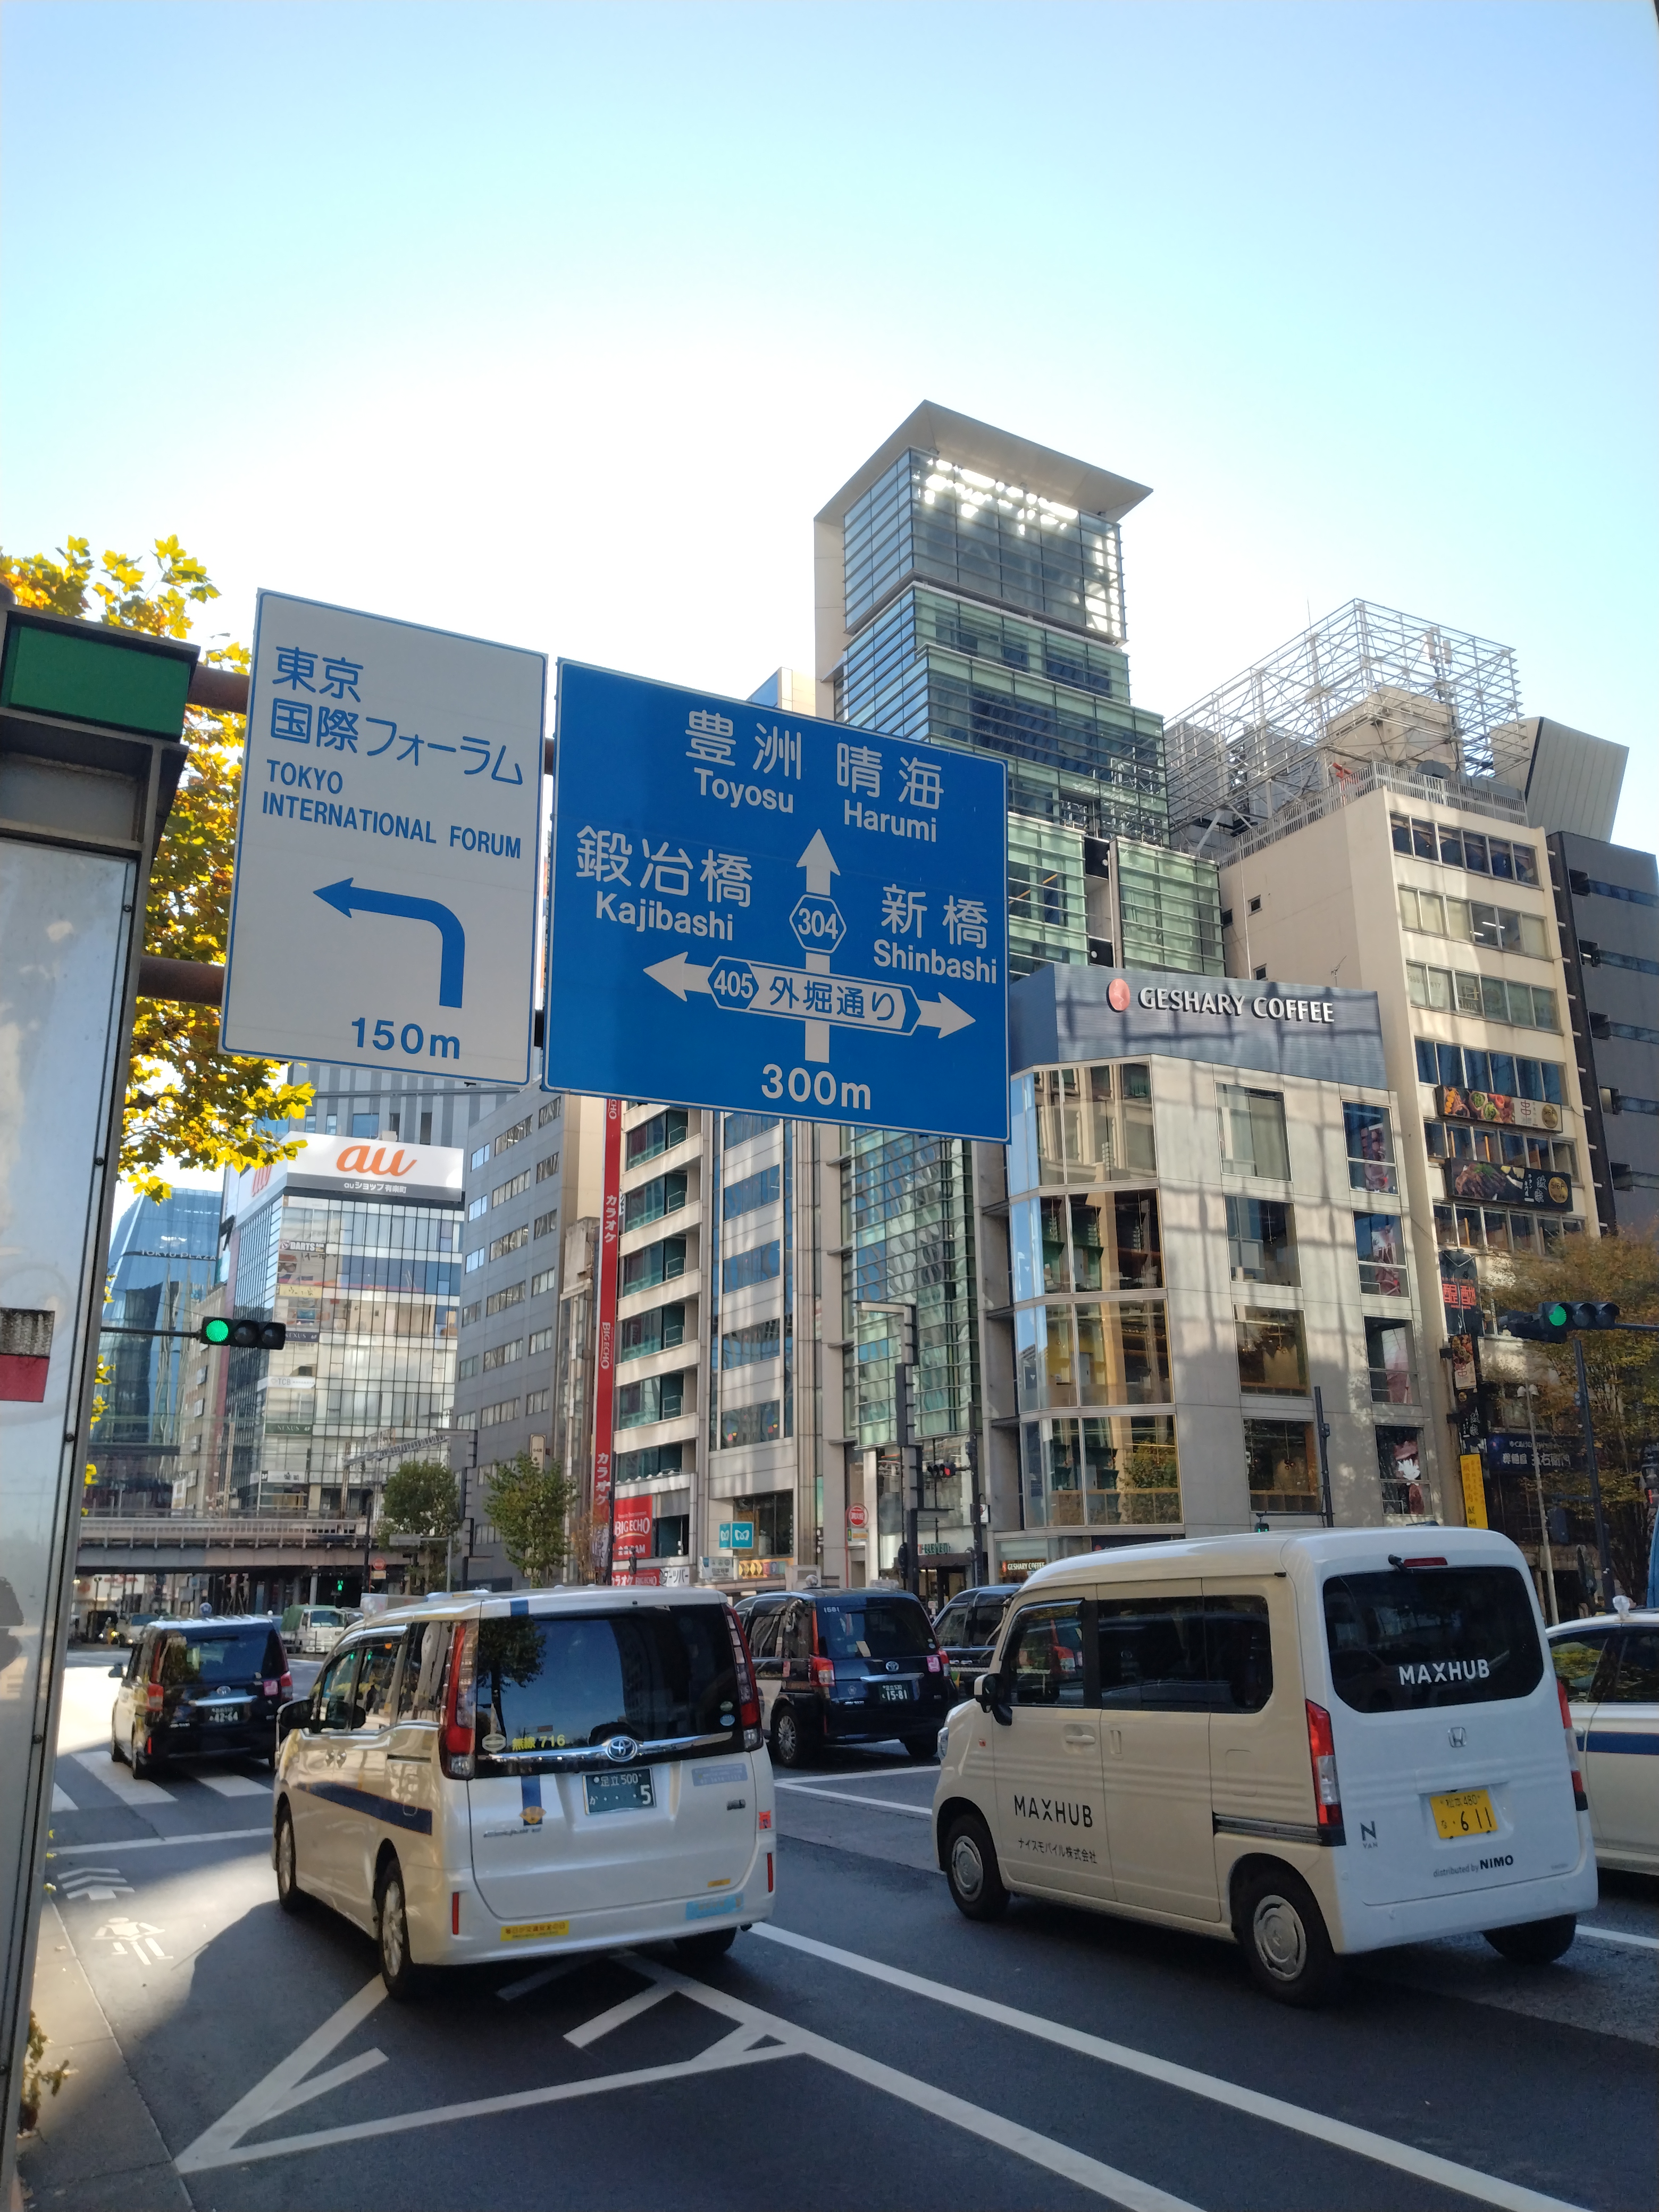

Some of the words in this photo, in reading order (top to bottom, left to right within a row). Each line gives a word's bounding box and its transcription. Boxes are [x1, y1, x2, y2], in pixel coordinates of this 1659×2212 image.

[273, 646, 364, 702] 東京
[270, 698, 523, 786] 国際フォーラム
[685, 709, 802, 781] 豊洲
[266, 759, 343, 795] TOKYO
[693, 767, 794, 814] Toyosu
[836, 741, 944, 810] 晴海
[262, 791, 437, 845] INTERNATIONAL
[449, 825, 522, 859] FORUM
[844, 800, 937, 843] Harumi
[575, 824, 753, 908] 鍛冶橋
[595, 890, 734, 941] Kajibashi
[798, 908, 839, 940] 304
[881, 883, 988, 950] 新橋
[873, 937, 998, 985] Shinbashi
[713, 968, 753, 1000] 405
[768, 975, 896, 1021] 外堀通り
[1138, 986, 1245, 1017] GESHARY
[1252, 996, 1335, 1024] COFFEE
[351, 1017, 460, 1060] 150m
[760, 1062, 872, 1110] 300m
[336, 1144, 417, 1177] au
[343, 1181, 407, 1194] auショップ有楽町
[604, 1194, 617, 1244] カラオケ
[290, 1242, 315, 1251] DARTS
[601, 1342, 610, 1370] ECHO
[595, 1452, 611, 1506] カラオケ
[614, 1520, 629, 1537] BIG
[629, 1517, 650, 1535] ECHO
[1007, 1562, 1028, 1571] GESHARY
[1398, 1658, 1490, 1686] MAXHUB
[540, 1734, 566, 1748] 716
[1014, 1795, 1093, 1828] MAXHUB
[1360, 1821, 1377, 1841] N
[1018, 1838, 1097, 1864] ナイスモバイル株式会社
[1433, 1863, 1471, 1878] distributed
[1471, 1862, 1479, 1873] by
[1480, 1854, 1514, 1870] NIMO
